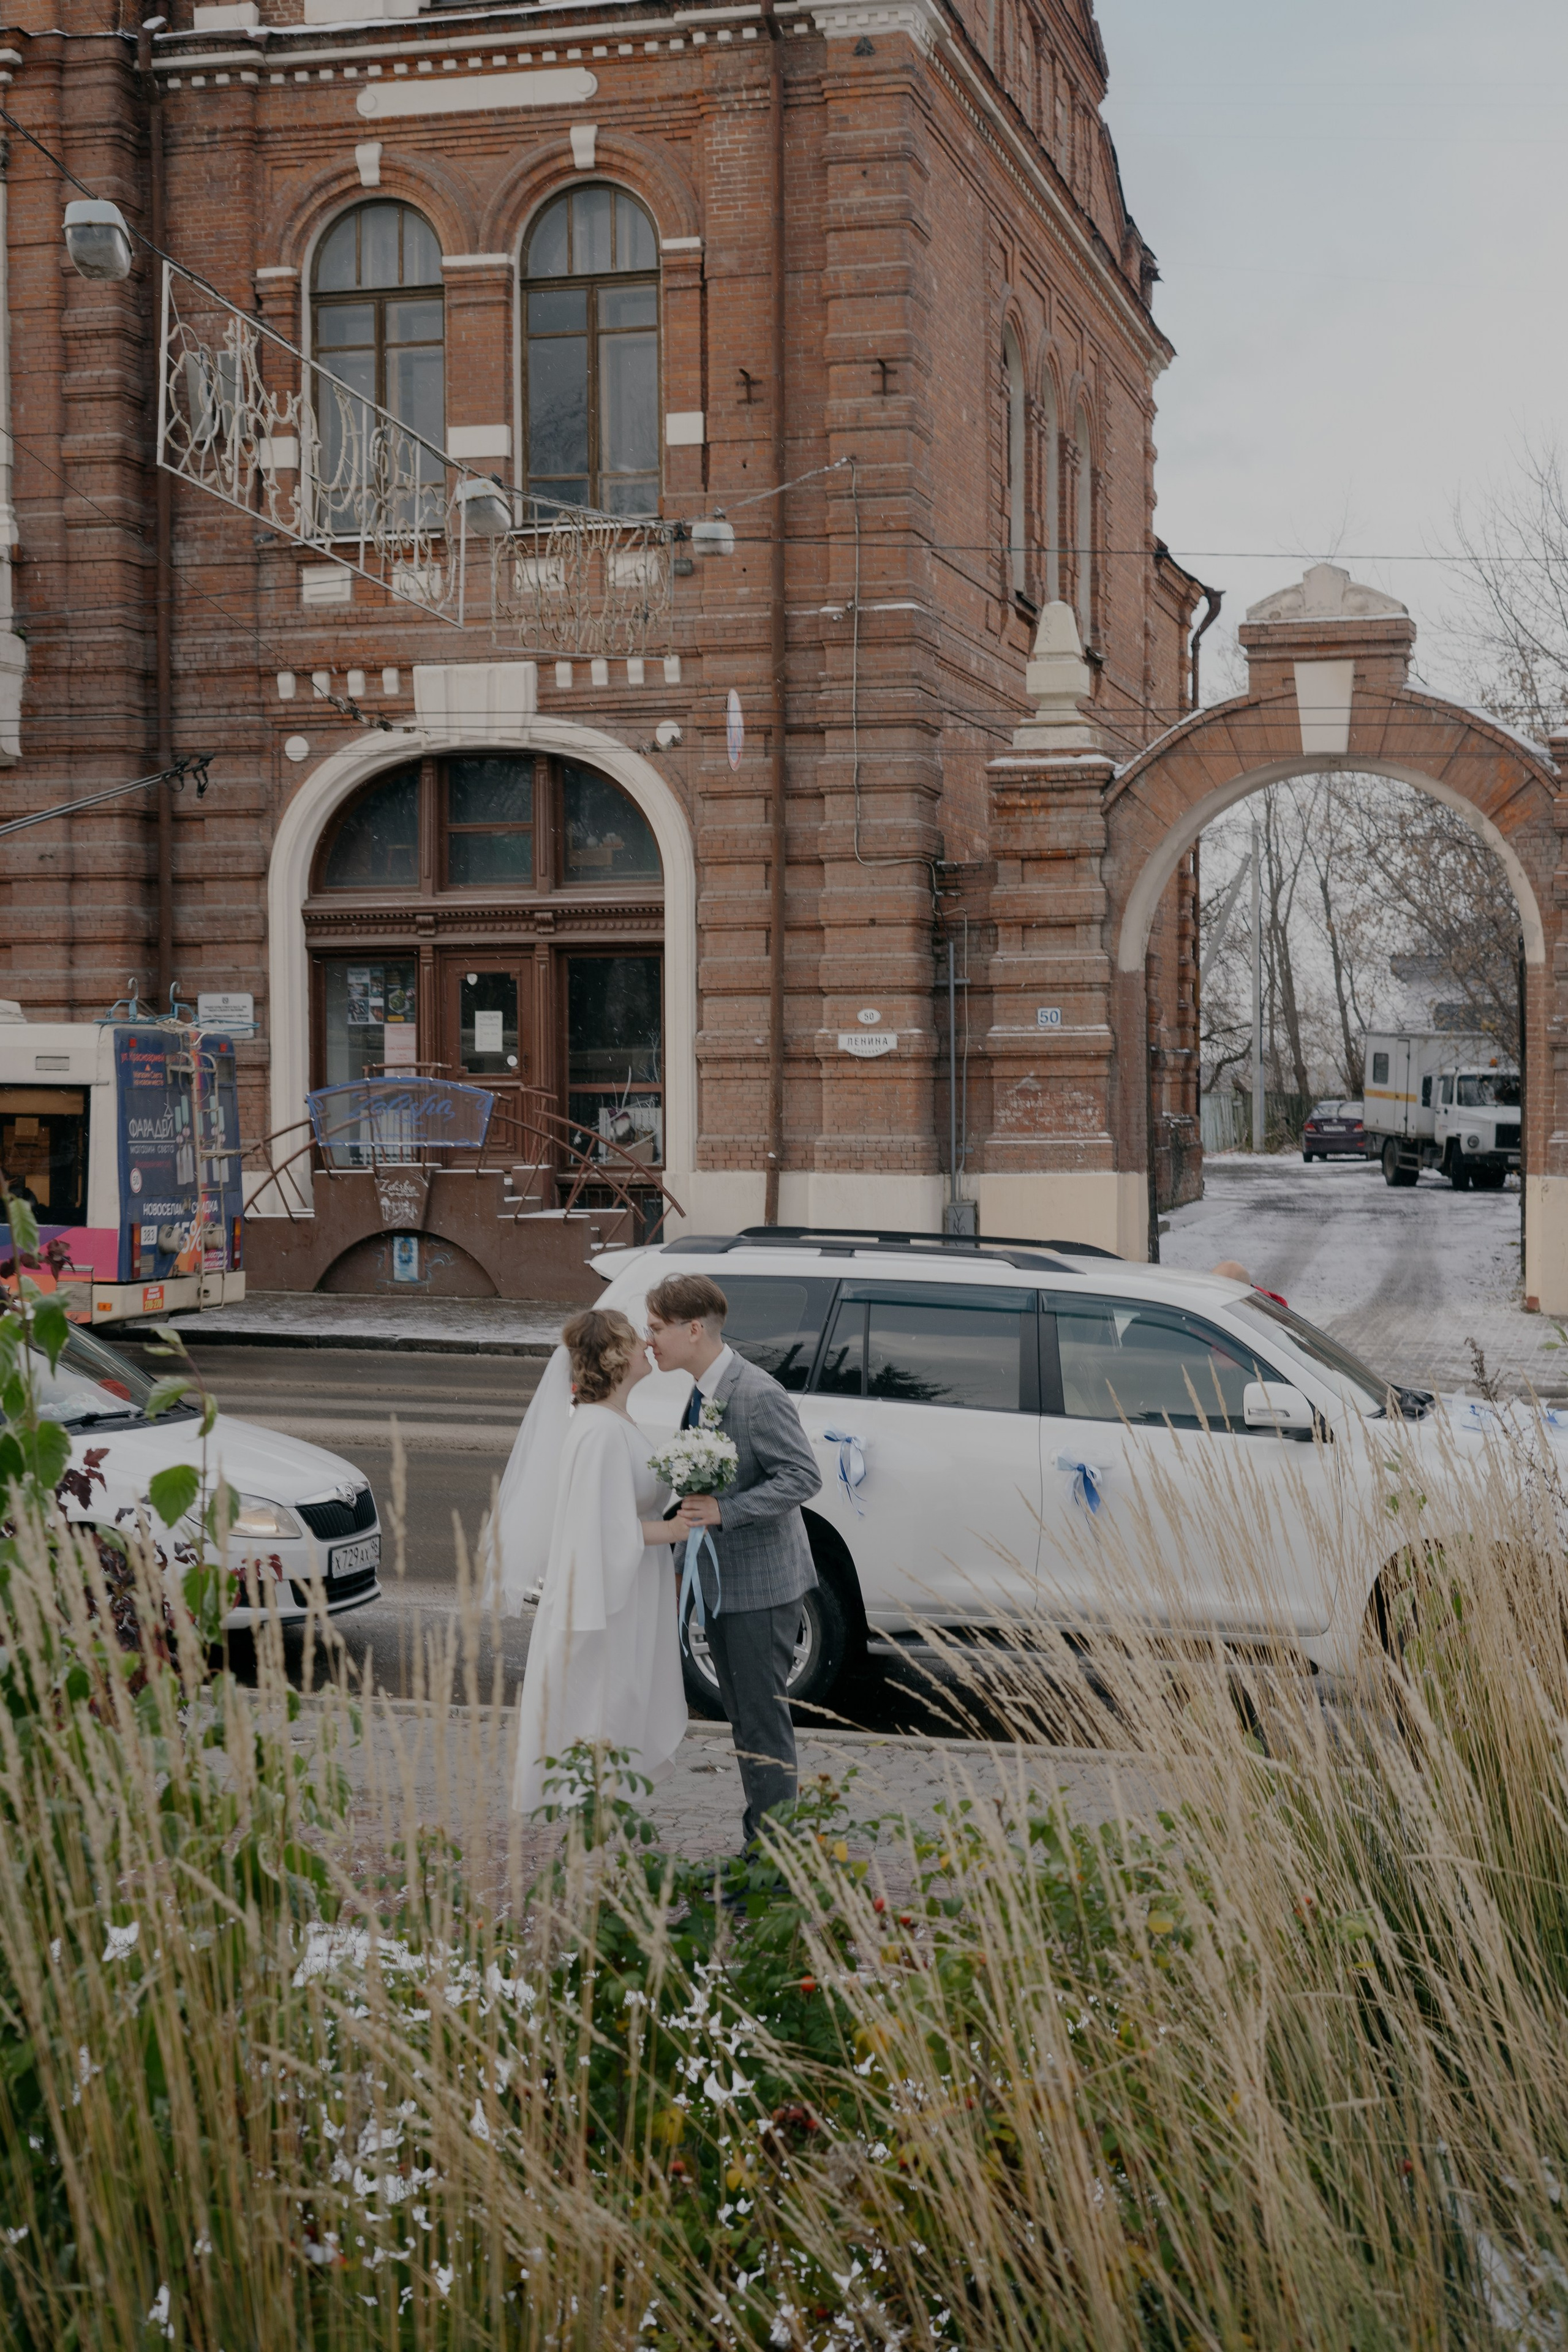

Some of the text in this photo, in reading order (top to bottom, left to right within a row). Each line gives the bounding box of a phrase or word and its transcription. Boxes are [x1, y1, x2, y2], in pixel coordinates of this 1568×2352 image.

[864, 1012, 875, 1021] 50
[1040, 1011, 1059, 1023] 50
[847, 1037, 889, 1046] ЛЕНИНА
[129, 1118, 174, 1139] ФАРАДЕЙ
[143, 1202, 186, 1216] НОВОСЕЛАМ
[143, 1229, 155, 1242] 383
